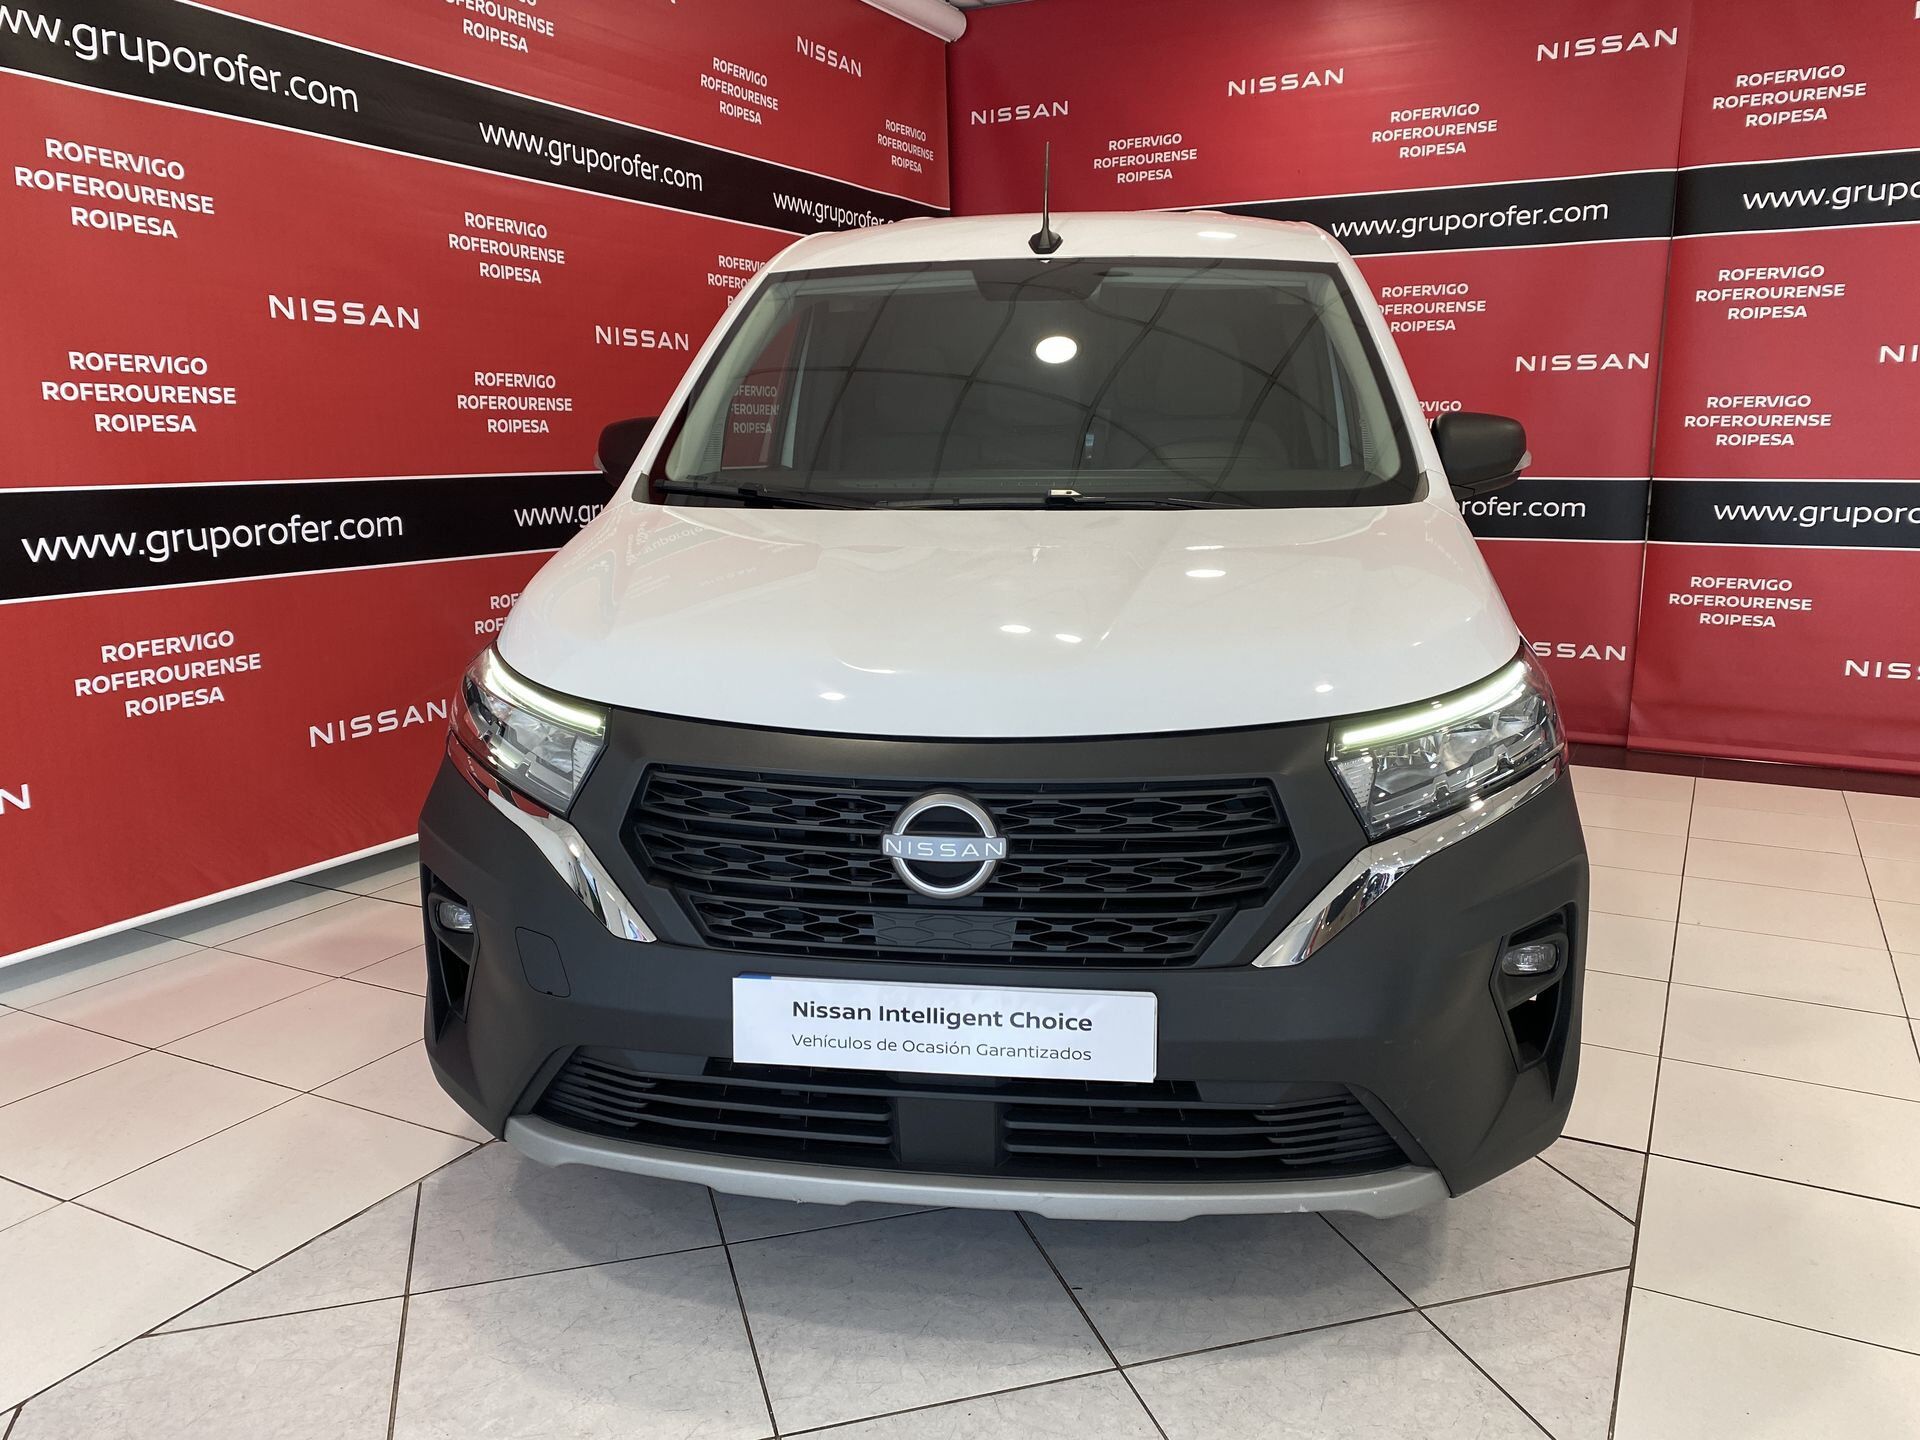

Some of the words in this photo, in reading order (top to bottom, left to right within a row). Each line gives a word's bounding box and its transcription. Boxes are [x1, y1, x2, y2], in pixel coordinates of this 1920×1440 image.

[446, 0, 556, 38] EROURENSE
[463, 18, 528, 53] ROIPESA
[1537, 28, 1677, 61] NISSAN
[0, 5, 359, 112] ww.gruporofer.com
[797, 36, 861, 77] NISSAN
[712, 56, 769, 88] ROFERVIGO
[1229, 68, 1343, 96] NISSAN
[1737, 65, 1845, 87] ROFERVIGO
[700, 73, 779, 111] ROFEROURENSE
[1713, 83, 1866, 109] ROFEROURENSE
[720, 101, 761, 124] ROIPESA
[972, 101, 1068, 124] NISSAN
[1391, 103, 1479, 122] ROFERVIGO
[1746, 108, 1827, 127] ROIPESA
[885, 119, 927, 142] ROFERVIGO
[1373, 120, 1497, 142] ROFEROURENSE
[877, 134, 935, 161] ROFEROURENSE
[1109, 134, 1182, 150] ROFERVIGO
[1400, 142, 1466, 158] ROIPESA
[46, 139, 184, 179] ROFERVIGO
[479, 122, 702, 191] www.gruporofer.com
[892, 155, 922, 172] ROIPESA
[1094, 149, 1197, 168] ROFEROURENSE
[1118, 169, 1172, 183] ROIPESA
[14, 166, 215, 216] ROFEROURENSE
[773, 192, 894, 227] www.gruporofer
[71, 207, 177, 238] ROIPESA
[465, 212, 547, 238] ROFERVIGO
[1332, 204, 1608, 238] www.gruporofer.com
[449, 234, 564, 264] ROFEROURENSE
[480, 263, 541, 283] ROIPESA
[718, 254, 766, 273] ROFERVI
[1719, 265, 1824, 281] ROFERVIGO
[1382, 284, 1468, 297] ROFERVIGO
[1696, 284, 1845, 301] ROFEROURENSE
[269, 295, 419, 329] NISSAN
[1380, 300, 1486, 316] FEROURENSE
[1728, 306, 1807, 319] ROIPESA
[1391, 320, 1455, 332] ROIPESA
[596, 326, 688, 350] NISSAN
[69, 352, 207, 375] ROFERVIGO
[1516, 353, 1649, 371] NISSAN
[475, 372, 555, 388] ROFERVIGO
[734, 385, 777, 397] FERVIGO
[42, 382, 236, 404] ROFEROURENSE
[458, 395, 572, 411] ROFEROURENSE
[1707, 395, 1811, 408] ROFERVIGO
[95, 414, 196, 432] ROIPESA
[488, 419, 549, 433] ROIPESA
[733, 422, 772, 433] ROIPESA
[1685, 415, 1831, 427] ROFEROURENSE
[1716, 434, 1794, 445] ROIPESA
[21, 515, 402, 562] www.gruporofer.com
[1691, 577, 1792, 591] ROFERVIGO
[1670, 594, 1812, 610] ROFEROURENSE
[1700, 613, 1775, 627] ROIPESA
[102, 631, 233, 663] ROFERVIGO
[1532, 642, 1626, 661] SSAN
[75, 654, 261, 696] ROFEROURENSE
[1844, 660, 1920, 680] NIS
[126, 687, 224, 717] ROIPESA
[310, 700, 446, 747] NISSAN
[885, 838, 1004, 858] NISSAN
[794, 1001, 870, 1020] Nissan
[880, 1006, 1002, 1029] Intelligent
[1010, 1012, 1092, 1031] Choice
[792, 1035, 871, 1049] Vehículos
[877, 1039, 896, 1051] de
[903, 1040, 970, 1054] Ocasión
[977, 1044, 1091, 1060] Garantizados
